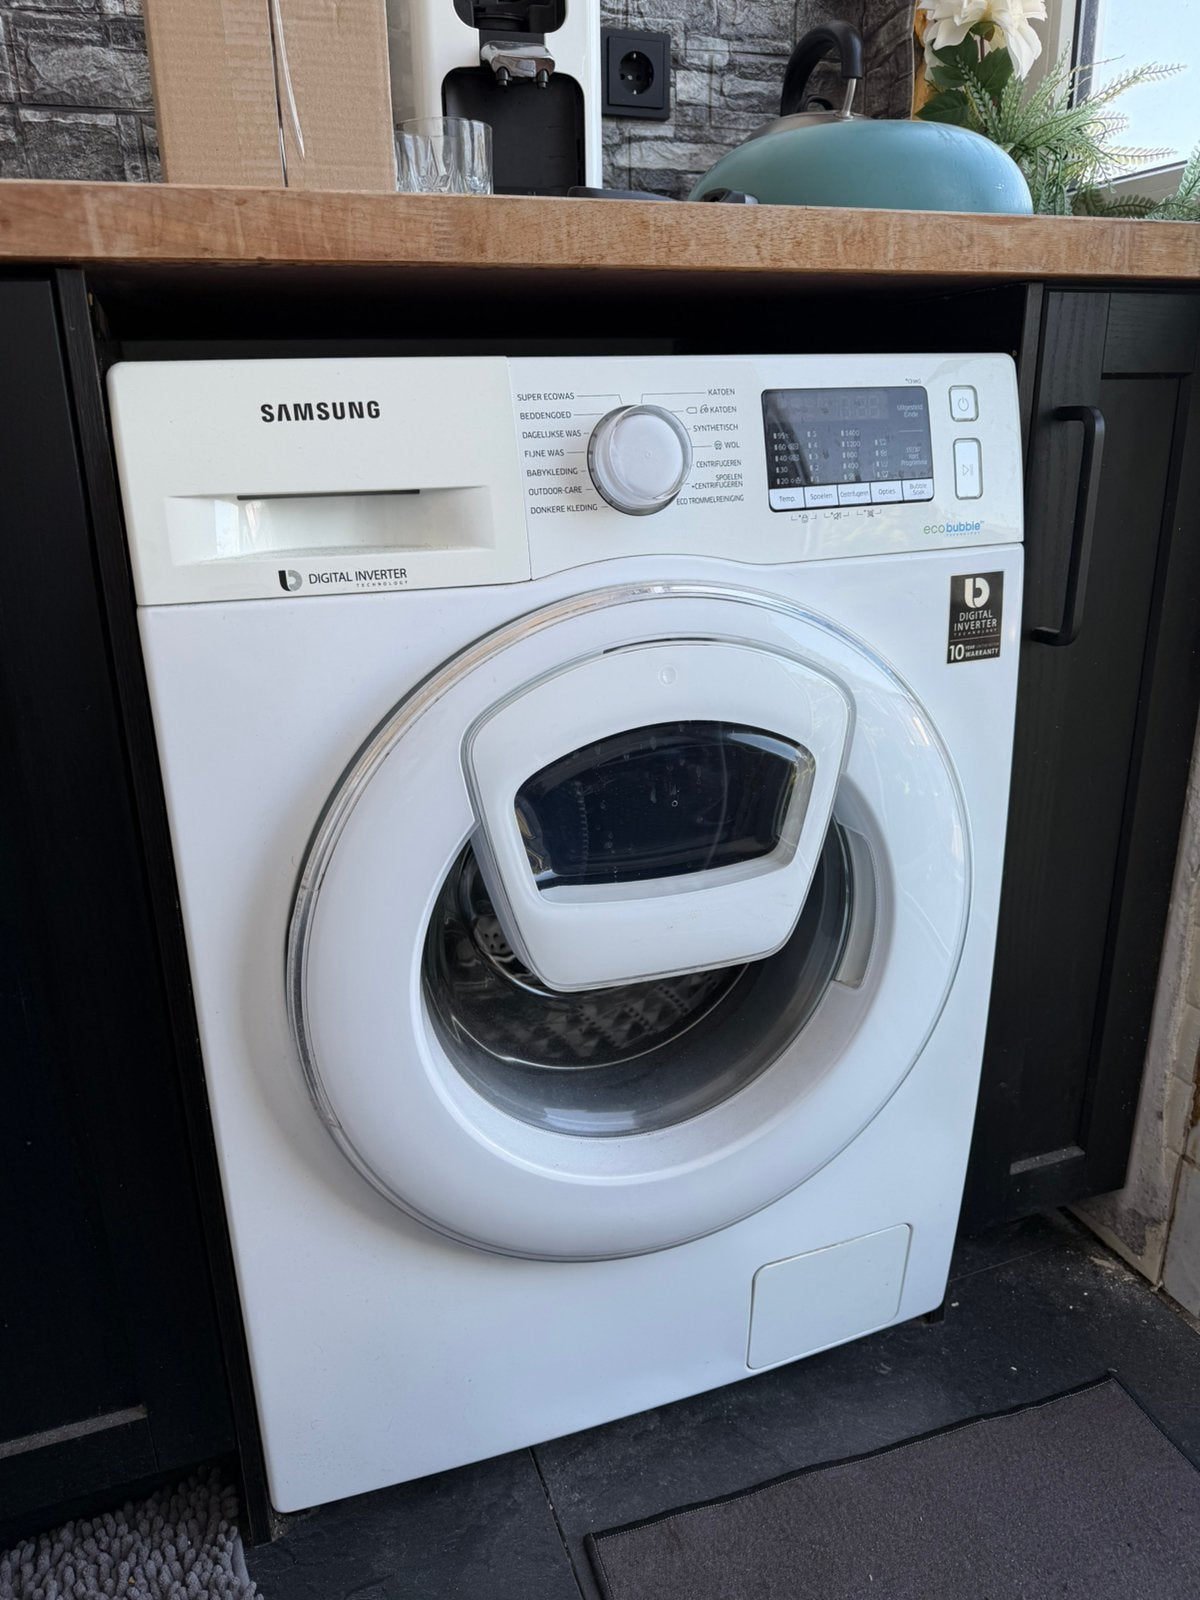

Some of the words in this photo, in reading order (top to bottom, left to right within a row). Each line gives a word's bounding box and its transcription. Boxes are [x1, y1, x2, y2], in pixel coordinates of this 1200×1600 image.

[517, 393, 542, 401] SUPER
[544, 392, 575, 400] ECOWAS
[707, 388, 735, 396] KATOEN
[260, 401, 381, 422] SAMSUNG
[519, 411, 571, 419] BEDDENGOED
[693, 424, 738, 432] SYNTHETISCH
[522, 430, 564, 438] DAGELIJKSE
[565, 429, 581, 437] WAS
[724, 441, 740, 449] WOL
[547, 449, 564, 457] WAS
[696, 460, 742, 468] CENTRIFUGEREN
[527, 468, 578, 477] BABYKLEDING
[715, 473, 743, 481] SPOELEN
[878, 488, 896, 496] Opties
[689, 495, 744, 504] TROMMELREINIGING
[810, 493, 833, 501] Spoelen
[531, 505, 565, 514] DONKERE
[567, 504, 598, 512] KLEDING
[308, 571, 352, 585] DIGITAL
[355, 568, 407, 581] INVERTER
[959, 610, 993, 621] DIGITAL
[954, 619, 997, 631] INVERTER
[949, 644, 964, 660] 10
[965, 648, 998, 657] WARRANTY
